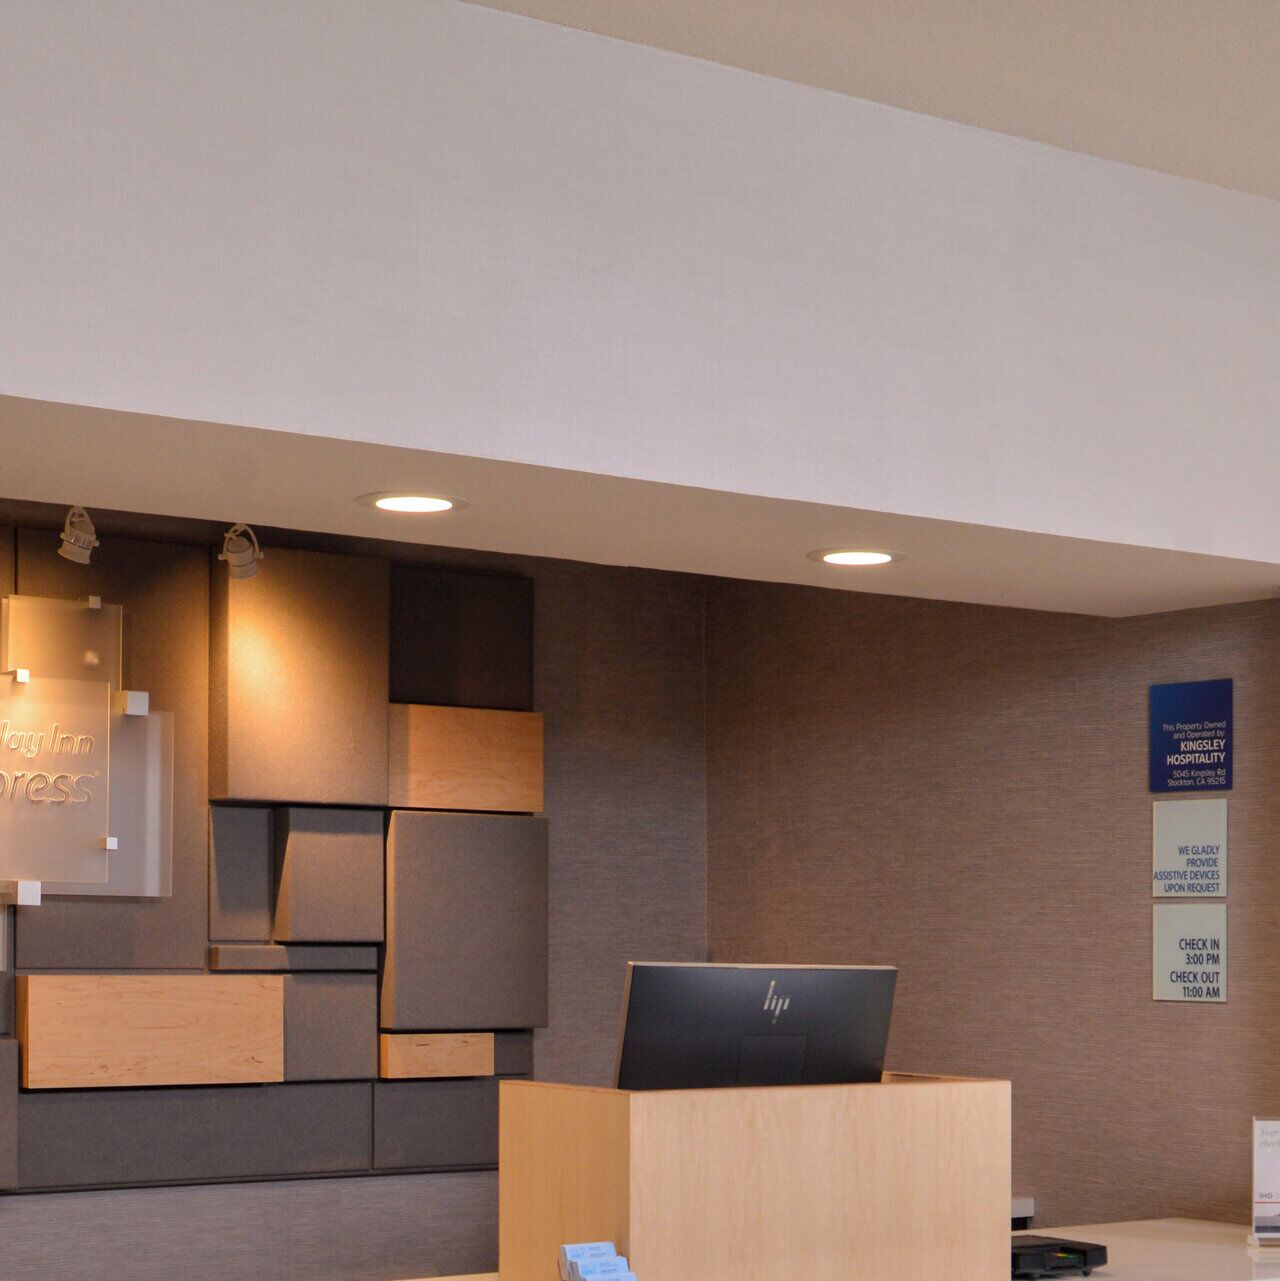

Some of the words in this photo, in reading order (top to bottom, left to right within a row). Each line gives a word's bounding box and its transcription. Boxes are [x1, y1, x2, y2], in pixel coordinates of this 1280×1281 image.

[1163, 724, 1175, 732] This
[1176, 723, 1202, 732] Property
[1204, 721, 1226, 730] Owned
[49, 723, 95, 754] Inn
[1187, 730, 1215, 740] Operated
[1180, 739, 1225, 751] KINGSLEY
[1167, 752, 1225, 765] HOSPITALITY
[1173, 770, 1190, 778] 5045
[1191, 769, 1216, 778] Kingsley
[1207, 777, 1226, 785] 95215
[1178, 846, 1190, 855] WE
[1191, 845, 1220, 855] GLADLY
[1186, 858, 1218, 867] PROVIDE
[1154, 871, 1188, 880] ASSISTIVE
[1190, 870, 1220, 880] DEVICES
[1164, 883, 1185, 893] UPON
[1187, 883, 1220, 893] REQUEST
[1179, 938, 1208, 950] CHECK
[1210, 938, 1220, 950] IN
[1185, 953, 1204, 965] 3:00
[1207, 953, 1220, 965] PM
[1170, 971, 1199, 983] CHECK
[1201, 971, 1220, 983] OUT
[1183, 986, 1203, 998] 11:00
[1206, 986, 1220, 998] AM
